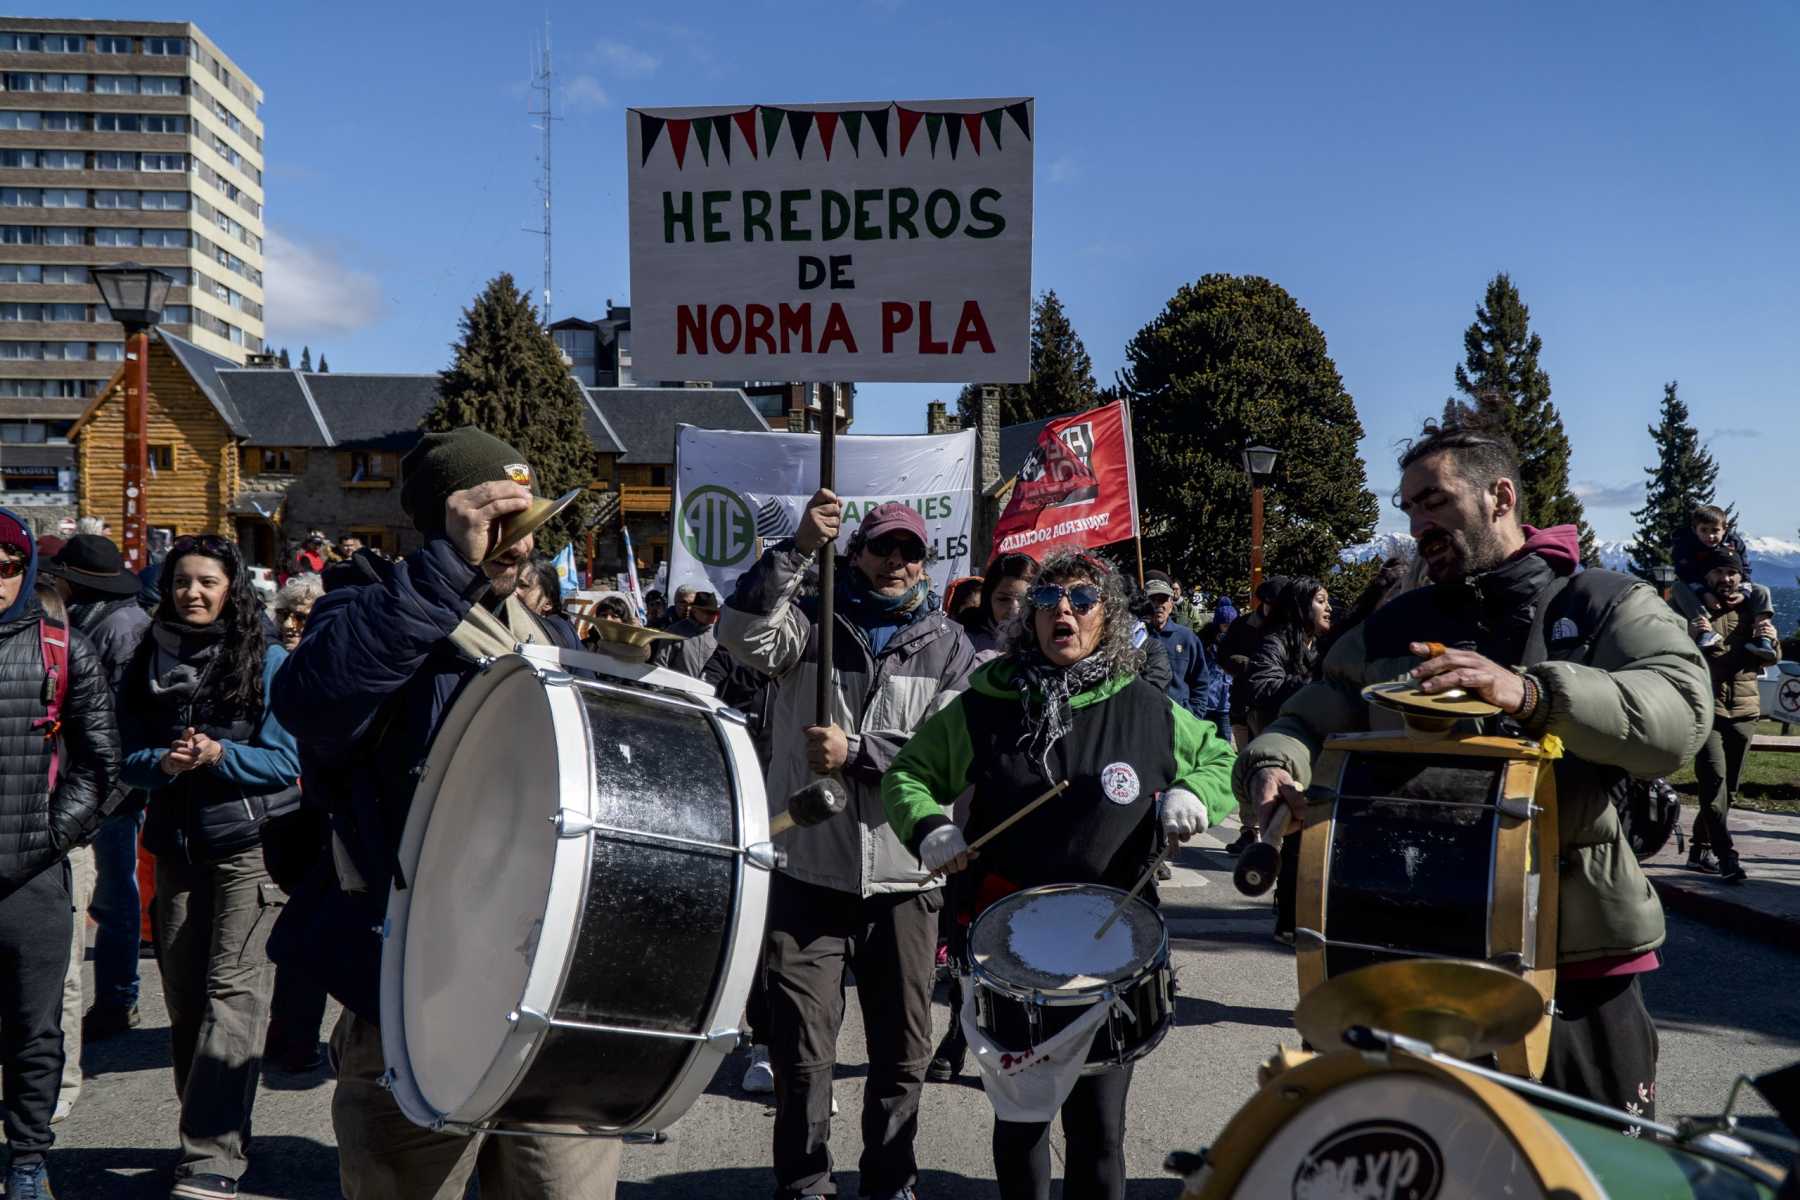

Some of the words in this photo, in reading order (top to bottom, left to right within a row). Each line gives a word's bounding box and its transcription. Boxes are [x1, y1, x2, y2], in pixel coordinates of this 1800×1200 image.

[663, 187, 1006, 243] HEREDEROS
[798, 254, 855, 290] DE
[676, 302, 858, 355] NORMA
[881, 300, 996, 354] PLA
[685, 491, 745, 561] ATE
